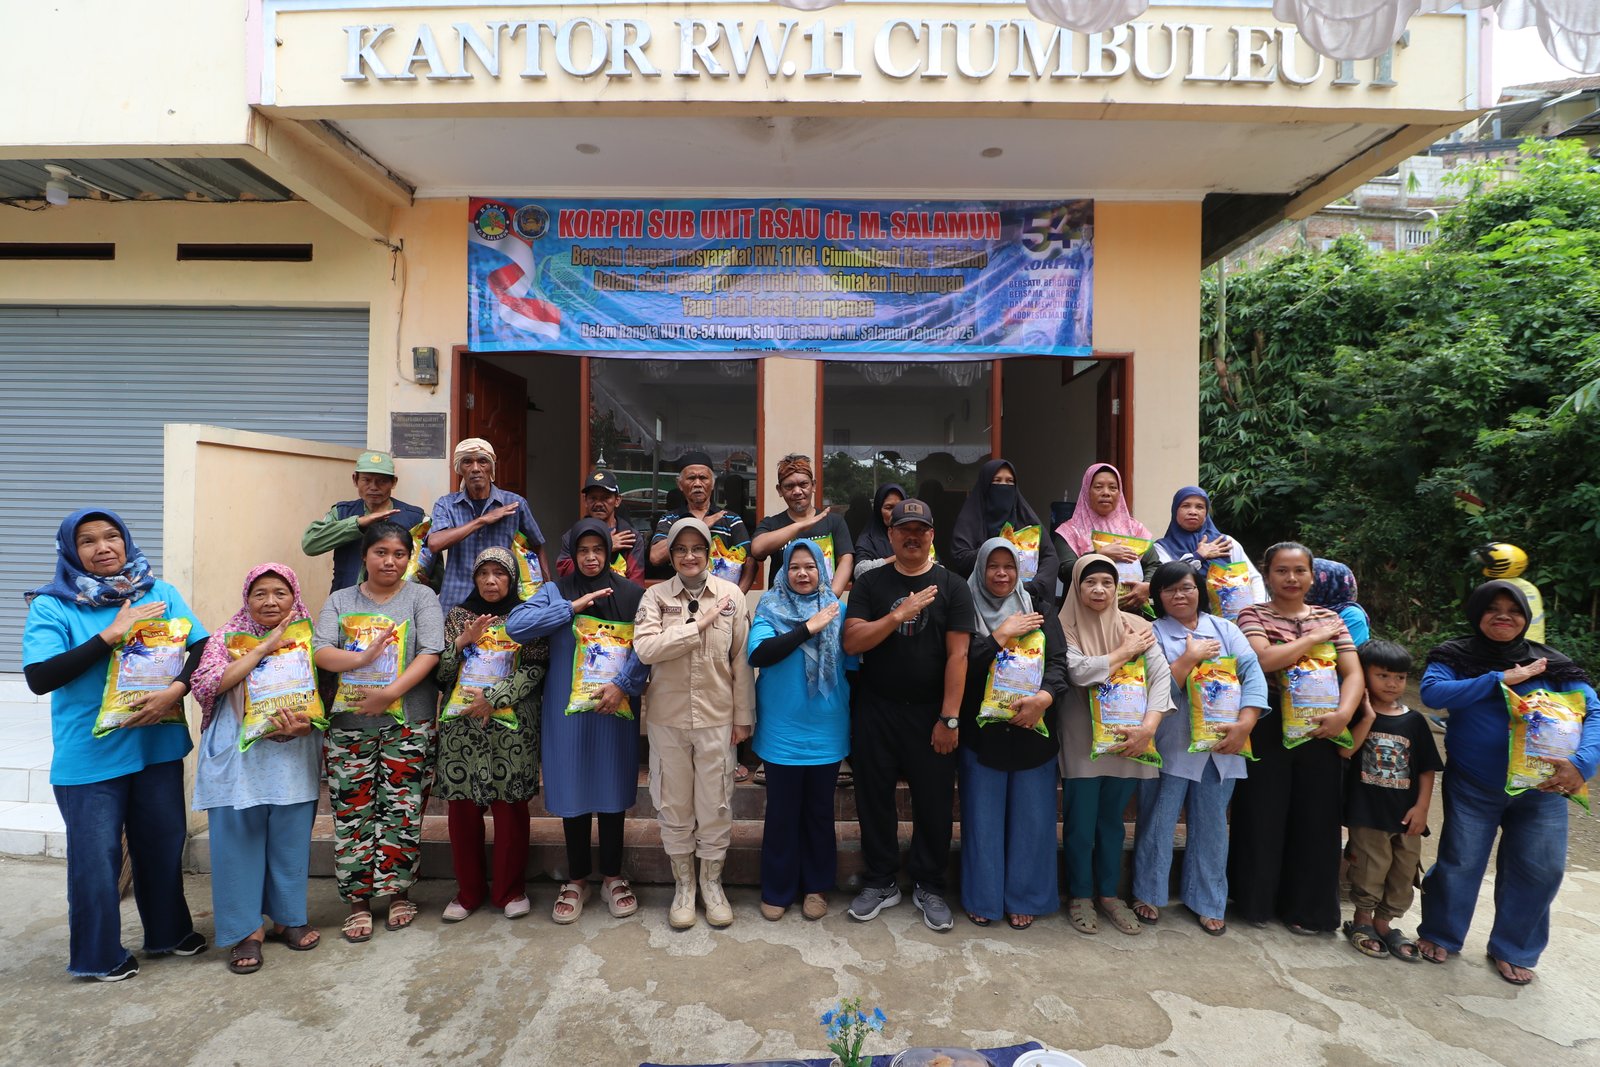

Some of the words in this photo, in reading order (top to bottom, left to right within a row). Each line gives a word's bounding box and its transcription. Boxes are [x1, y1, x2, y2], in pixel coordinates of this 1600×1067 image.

[341, 16, 662, 83] KANTOR
[673, 17, 863, 80] RW.11
[558, 208, 645, 239] KORPRI
[648, 208, 696, 240] SUB
[701, 208, 755, 240] UNIT
[758, 208, 820, 240] RSAU
[824, 208, 855, 240] dr.
[858, 210, 887, 240] M.
[890, 211, 1002, 241] SALAMUN
[571, 244, 623, 267] Bersatu
[624, 245, 673, 269] dengan
[675, 246, 752, 269] masyarakat
[754, 245, 779, 267] RW.
[780, 245, 793, 267] 11
[795, 245, 819, 267] Kel.
[821, 246, 902, 269] Ciumbuleuit
[593, 270, 637, 292] Dalam
[637, 270, 665, 292] aksi
[667, 272, 713, 294] gotong
[715, 273, 760, 294] royong
[762, 271, 800, 293] untuk
[801, 271, 888, 294] menciptakan
[889, 273, 965, 295] lingkungan
[681, 296, 713, 319] Yang
[749, 296, 793, 318] bersih
[794, 296, 822, 318] dan
[823, 298, 875, 319] nyaman
[580, 323, 617, 339] Dalam
[618, 324, 659, 340] Rangka
[660, 324, 683, 339] HUT
[683, 324, 716, 340] Ke-54
[717, 324, 752, 341] Korpri
[752, 324, 775, 340] Sub
[775, 324, 801, 340] Unit
[800, 325, 829, 341] RSAU
[829, 325, 845, 341] dr.
[845, 325, 859, 341] M.
[860, 325, 909, 341] Salamun
[910, 326, 944, 341] Tahun
[945, 325, 975, 341] 2025
